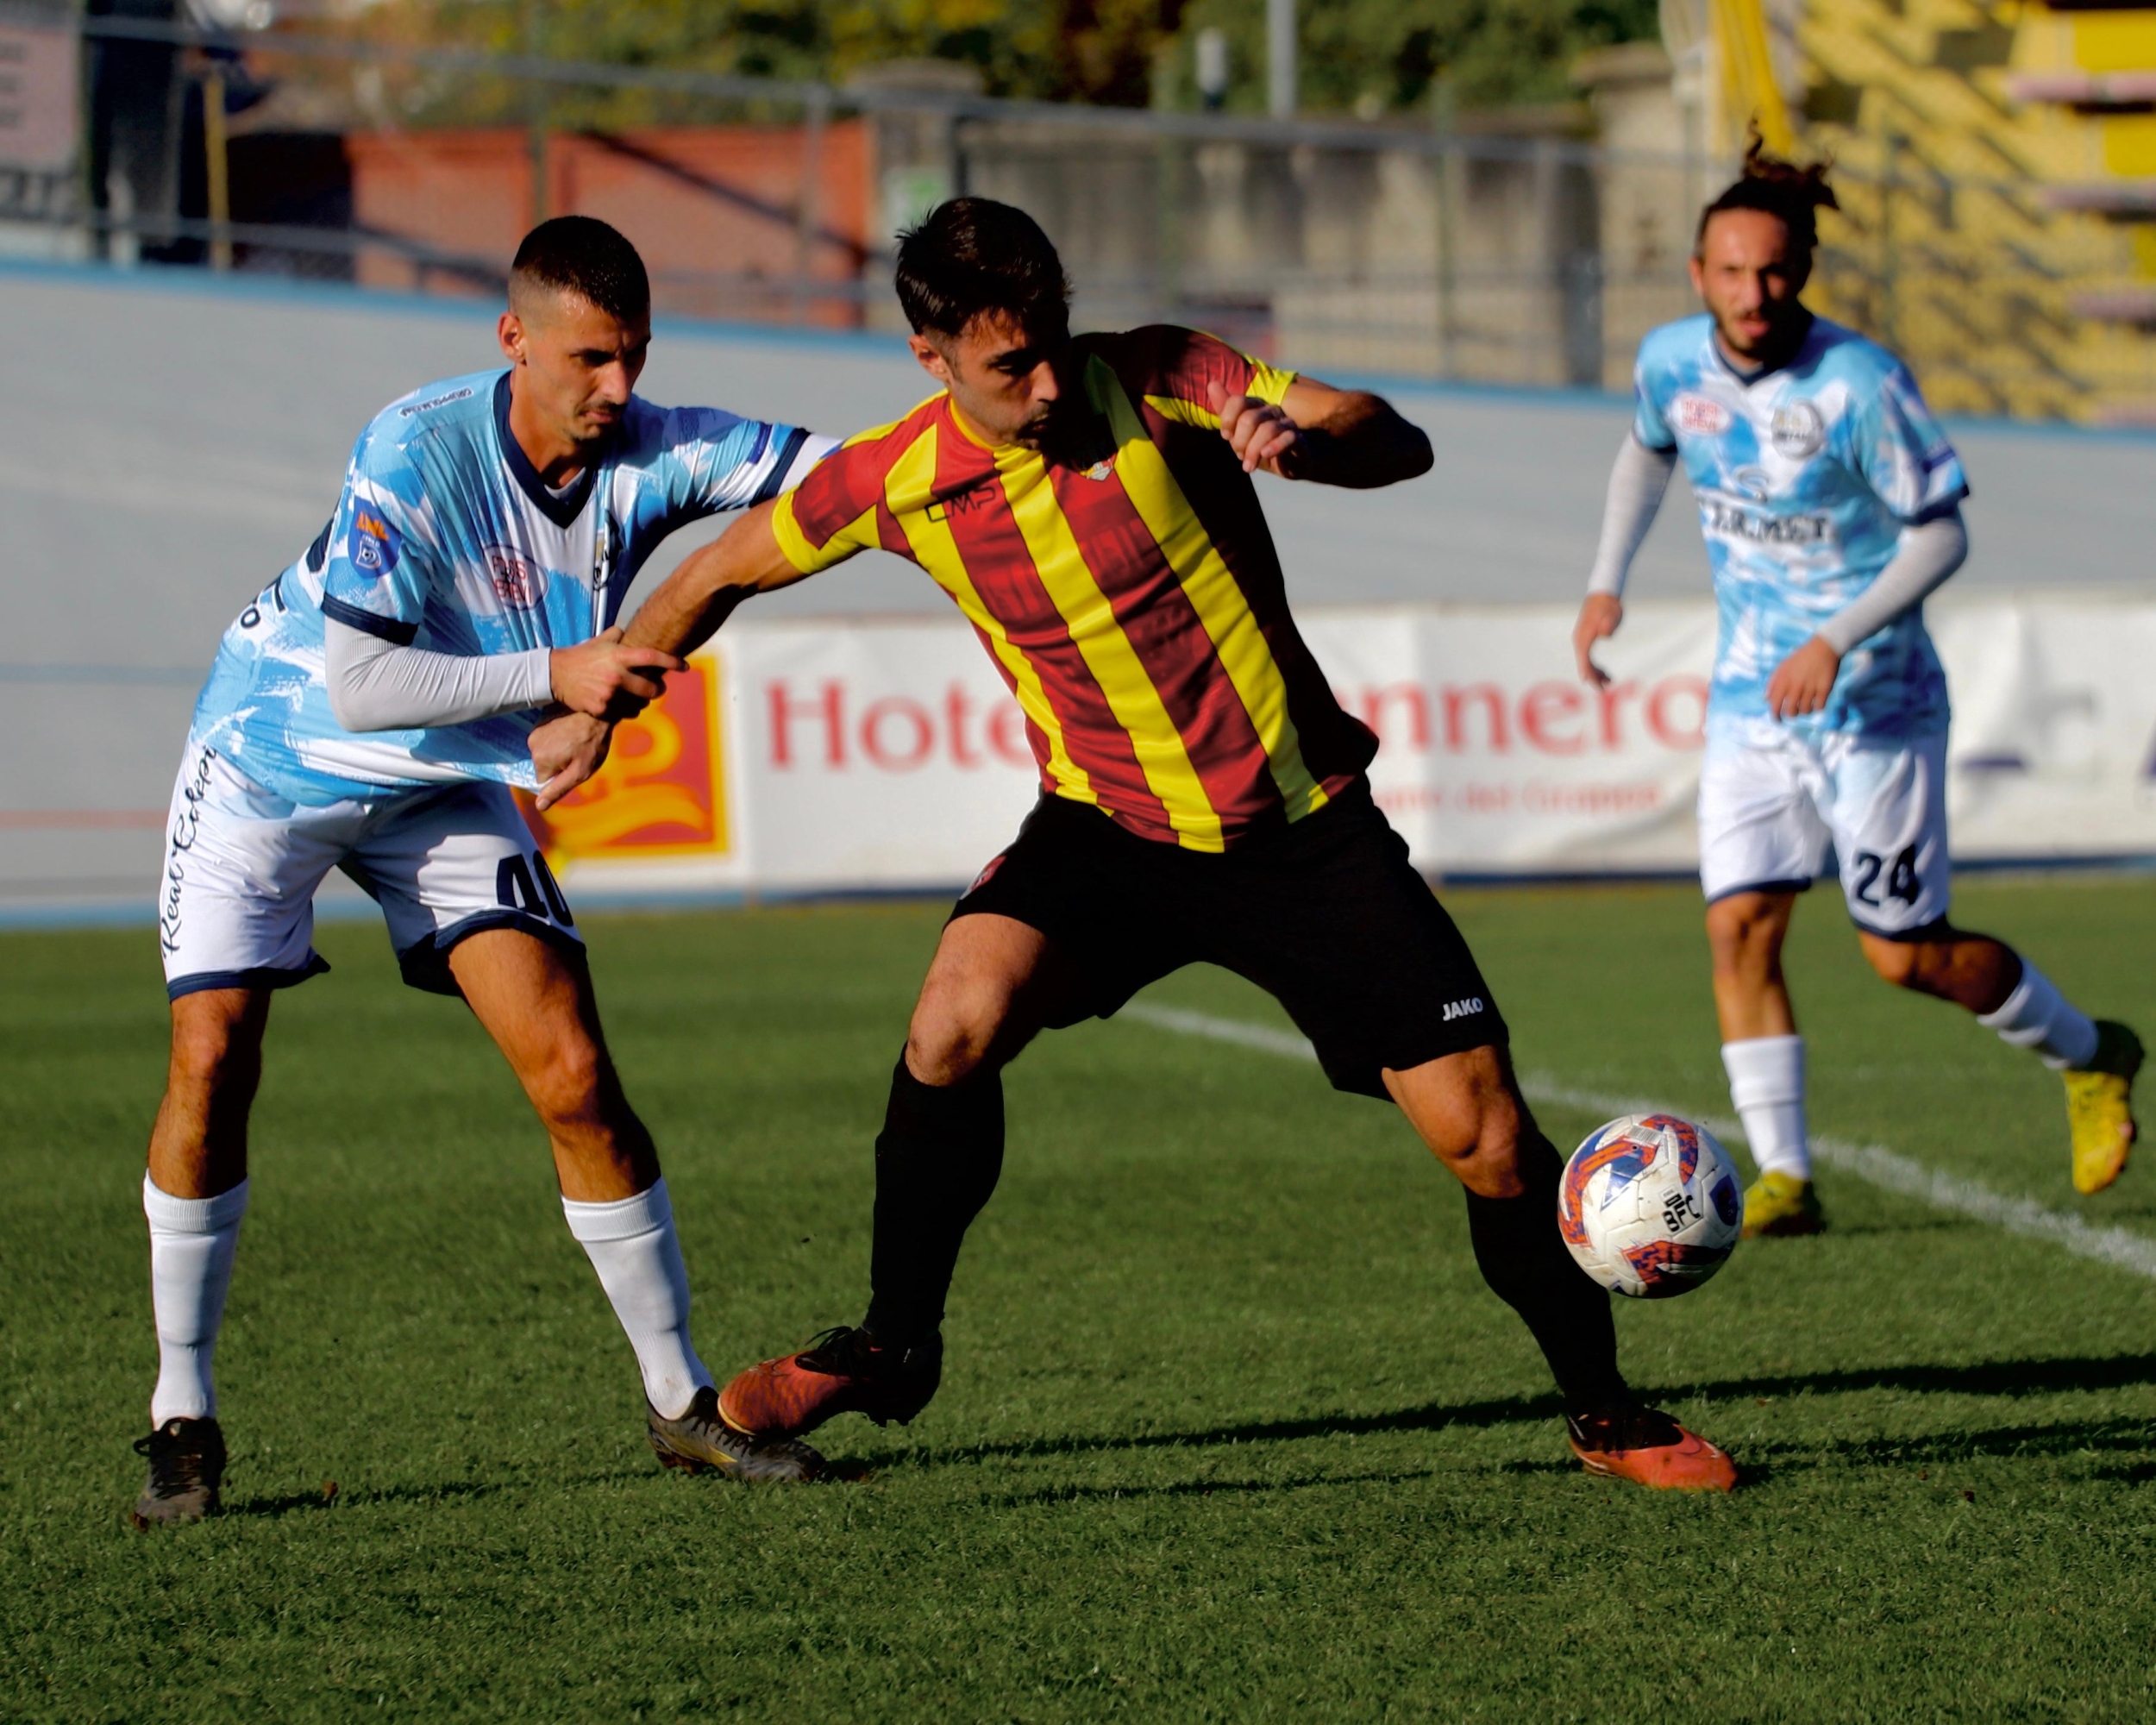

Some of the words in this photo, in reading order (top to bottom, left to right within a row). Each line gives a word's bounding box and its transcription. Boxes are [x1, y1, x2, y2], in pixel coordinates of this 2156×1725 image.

[924, 486, 996, 524] CMP
[1359, 676, 1708, 756] nnero
[496, 850, 574, 928] 40
[1856, 843, 1921, 906] 24
[156, 862, 185, 959] Real
[1443, 997, 1483, 1021] JAKO
